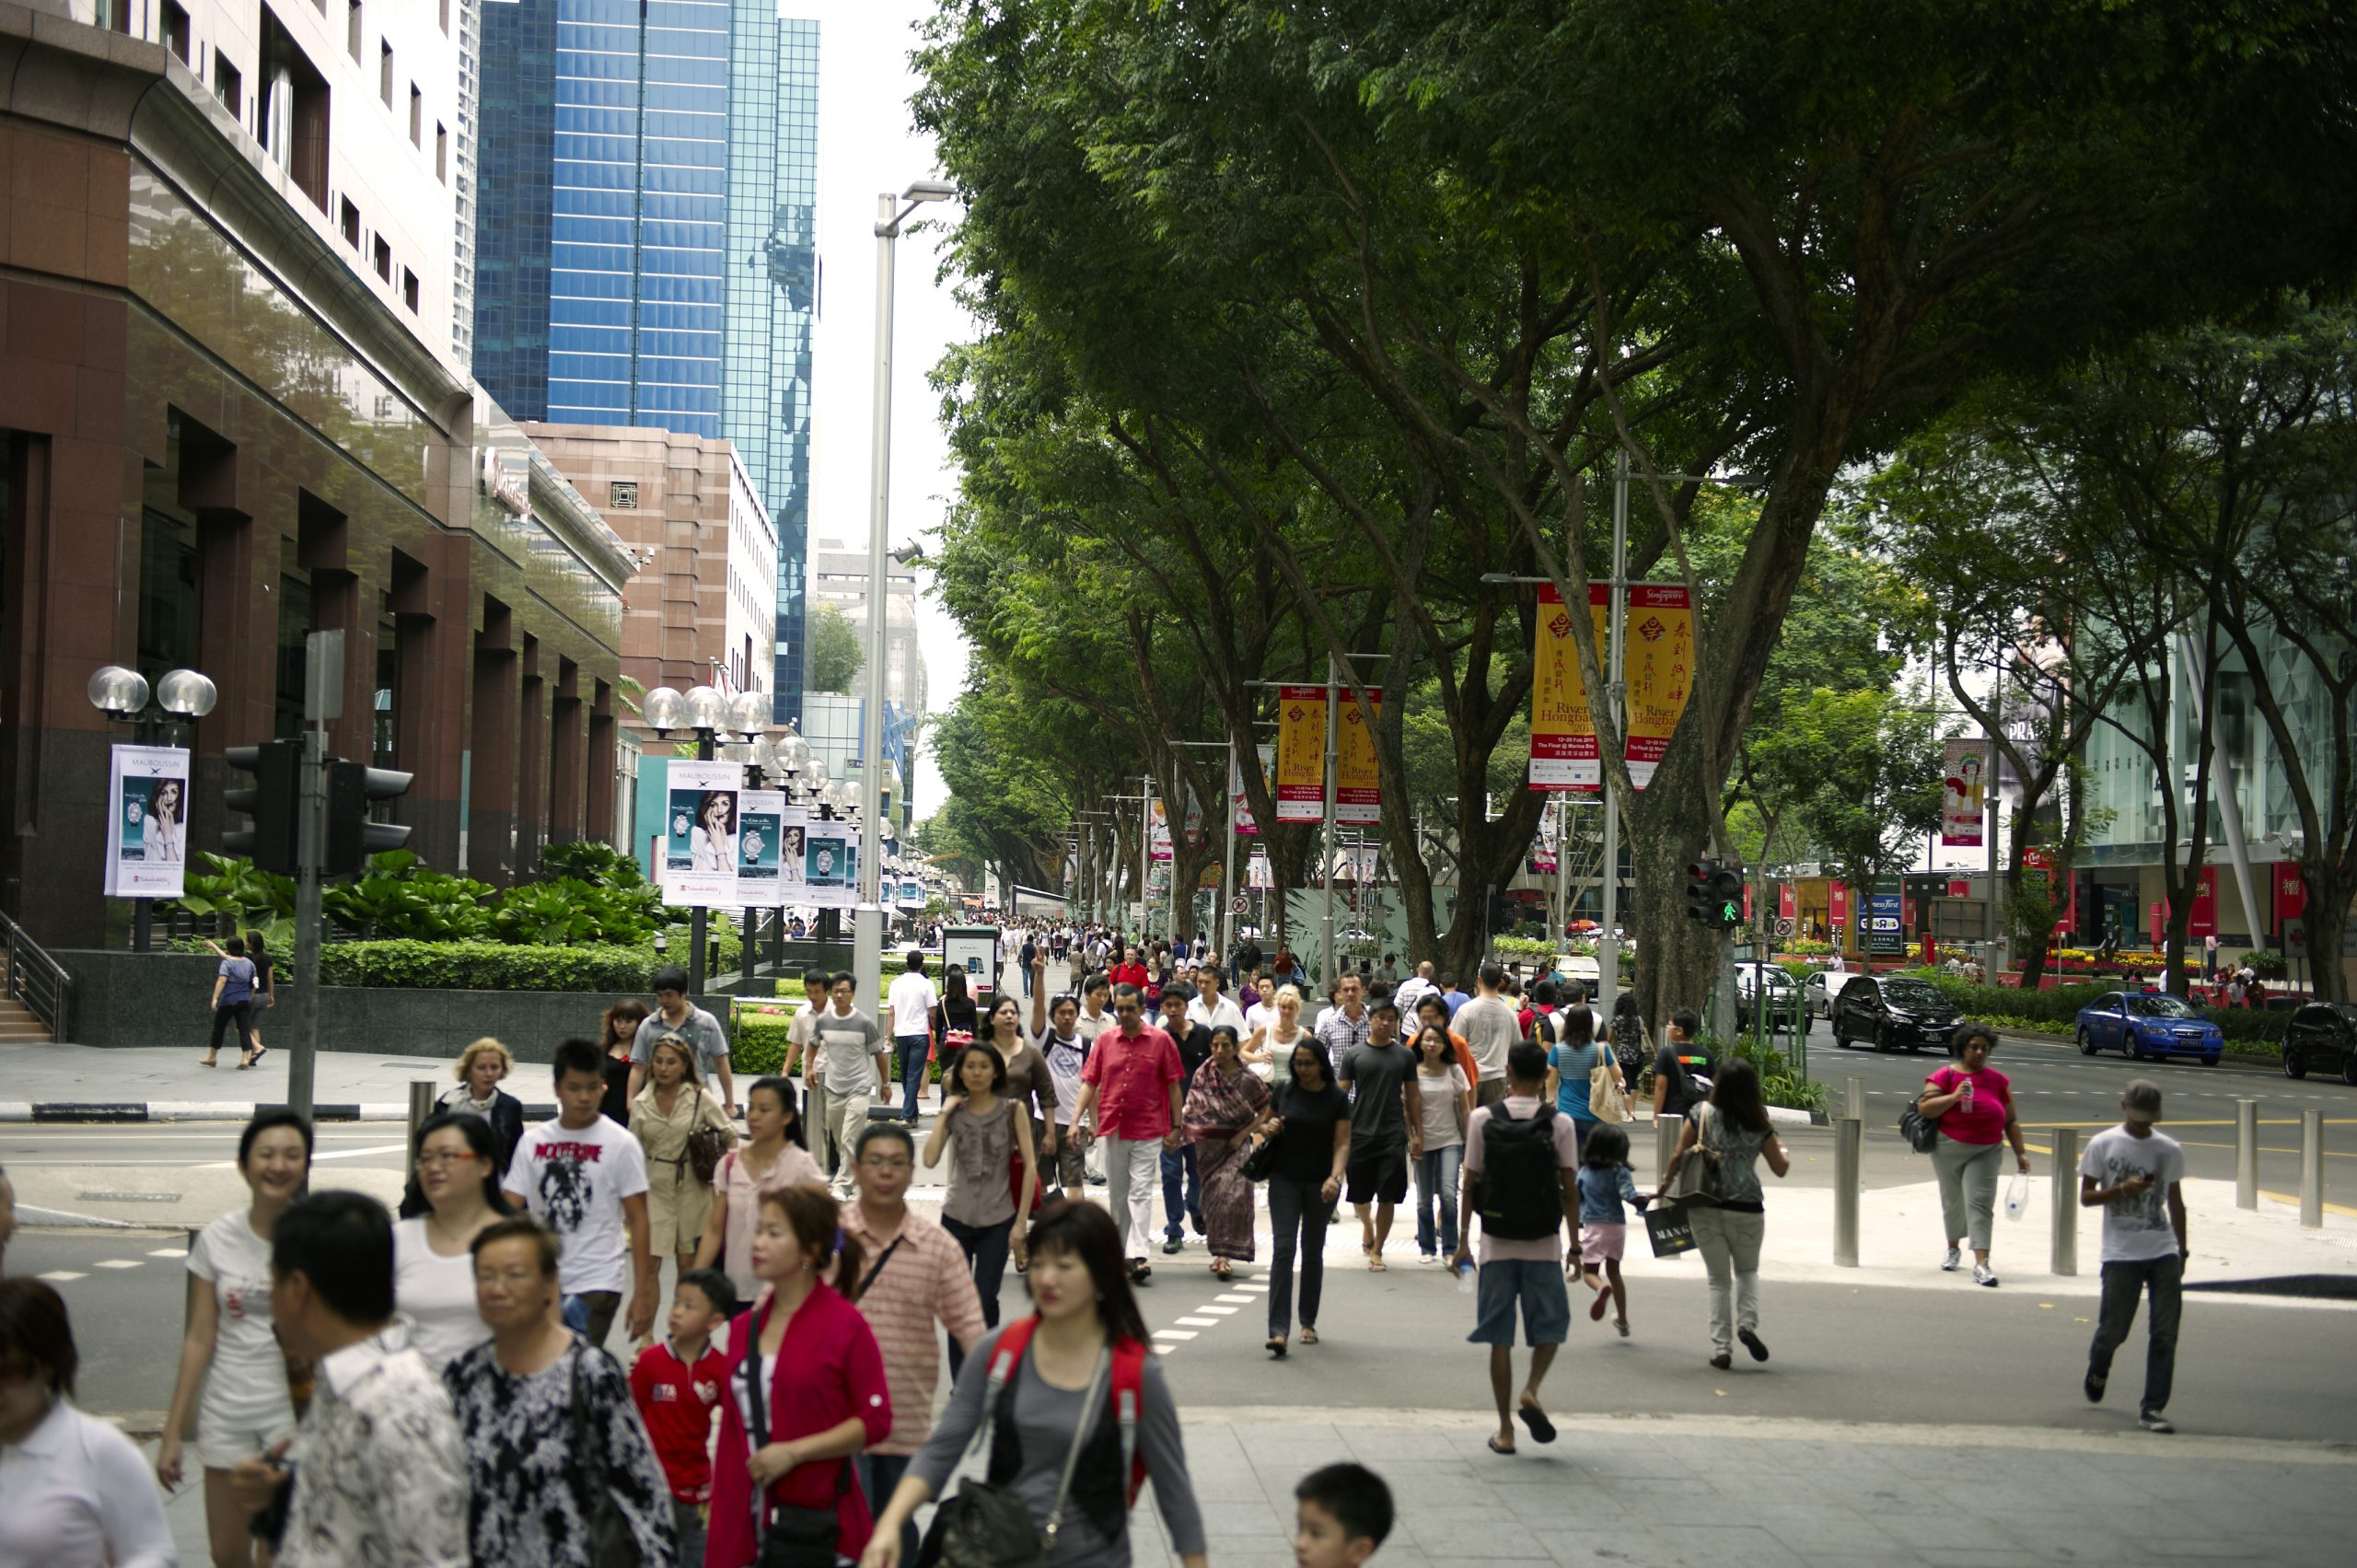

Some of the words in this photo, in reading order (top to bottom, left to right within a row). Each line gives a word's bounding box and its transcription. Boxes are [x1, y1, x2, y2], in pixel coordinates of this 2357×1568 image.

[1556, 702, 1589, 714] River
[1645, 705, 1677, 717] River
[1541, 709, 1593, 726] Hongba
[1635, 713, 1680, 727] Hongba
[132, 758, 181, 768] MAUBOUSSIN
[1294, 763, 1316, 772] River
[1283, 769, 1321, 778] Hongbao
[1352, 767, 1374, 775] River
[679, 772, 731, 781] MAUBOUSSIN
[1883, 899, 1899, 910] First
